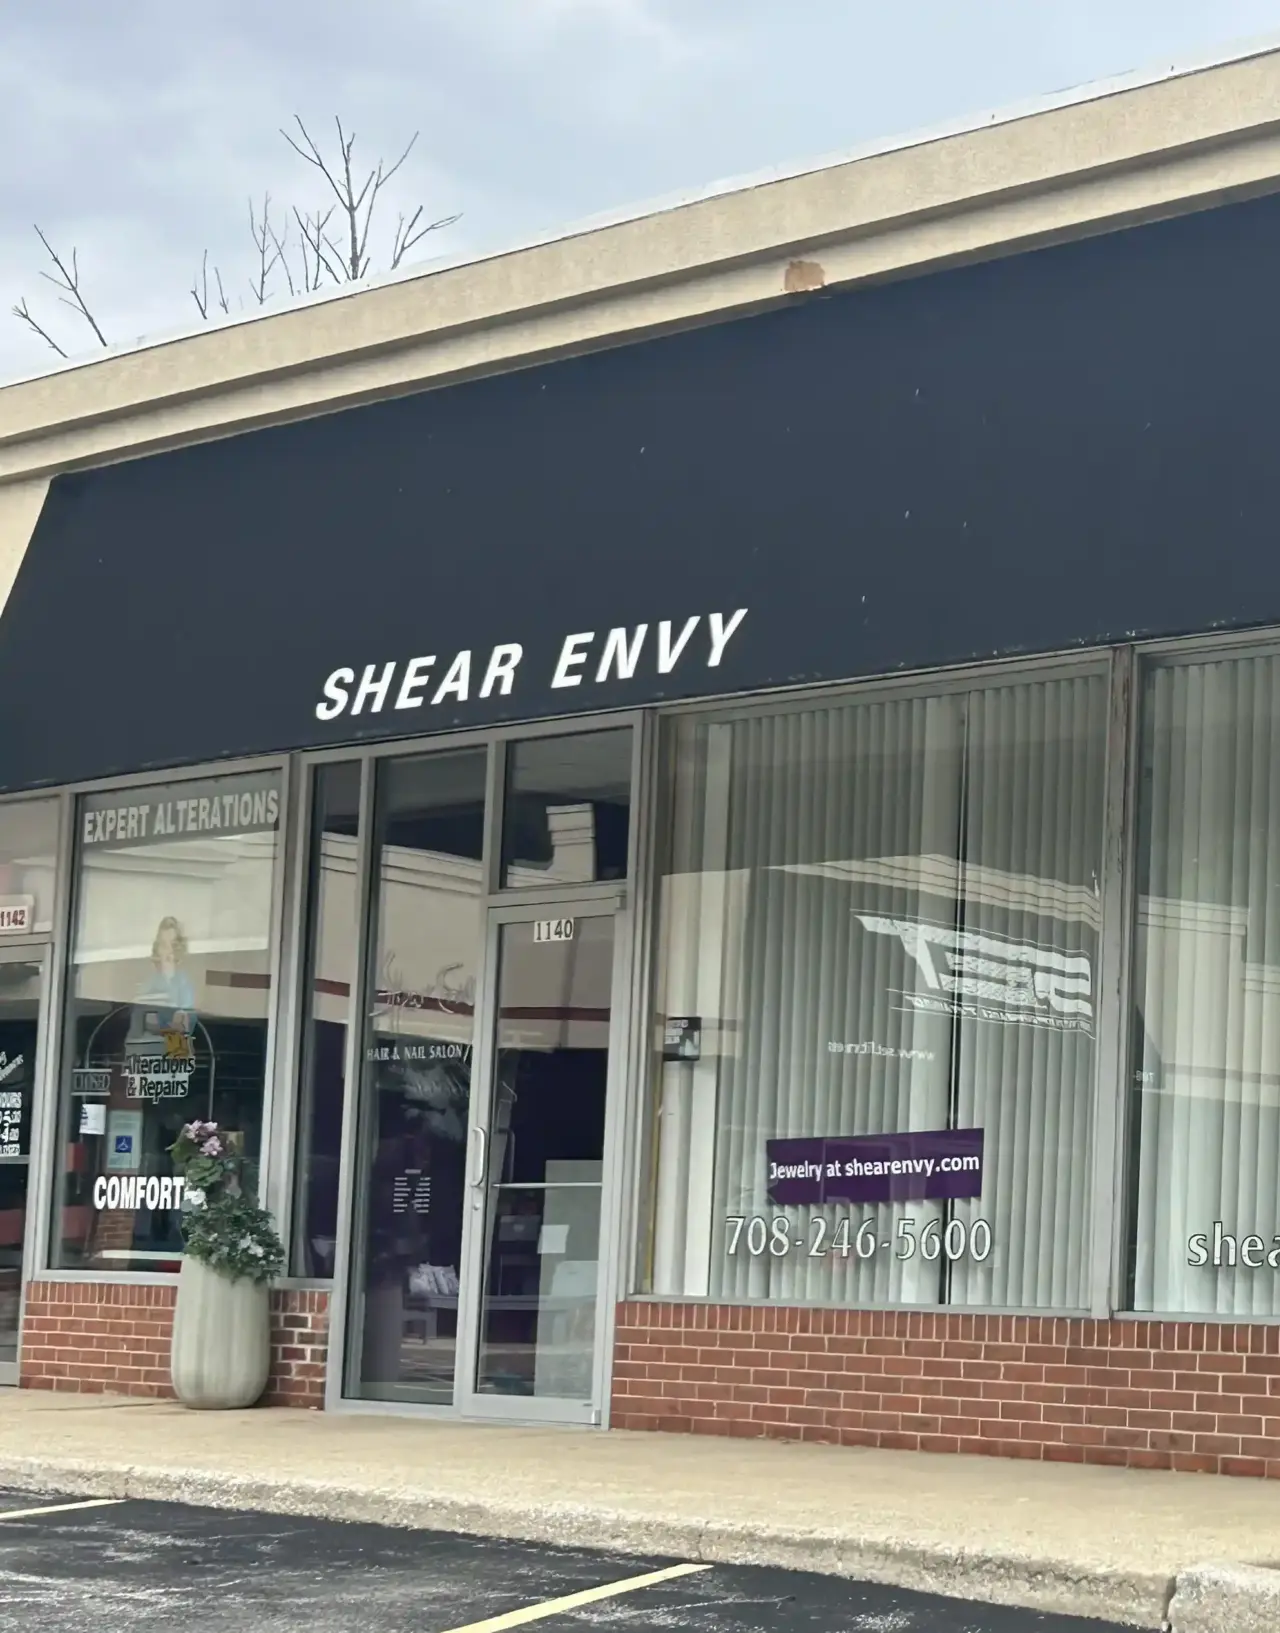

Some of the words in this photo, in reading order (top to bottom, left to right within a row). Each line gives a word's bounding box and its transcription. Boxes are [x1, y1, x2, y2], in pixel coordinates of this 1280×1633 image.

[315, 642, 524, 721] SHEAR
[550, 608, 748, 689] ENVY
[83, 805, 149, 843] EXPERT
[153, 789, 279, 835] ALTERATIONS
[0, 909, 26, 927] 1142
[535, 919, 573, 940] 1140
[123, 1053, 196, 1074] Alterations
[367, 1047, 389, 1060] HAIR
[405, 1045, 425, 1059] NAIL
[430, 1044, 461, 1059] SALON
[139, 1074, 188, 1102] Repairs
[770, 1160, 822, 1181] Jewelry
[827, 1161, 841, 1177] at
[845, 1154, 979, 1177] shearenvy.com
[94, 1176, 184, 1210] COMFORT
[725, 1215, 992, 1262] 708-246-5600
